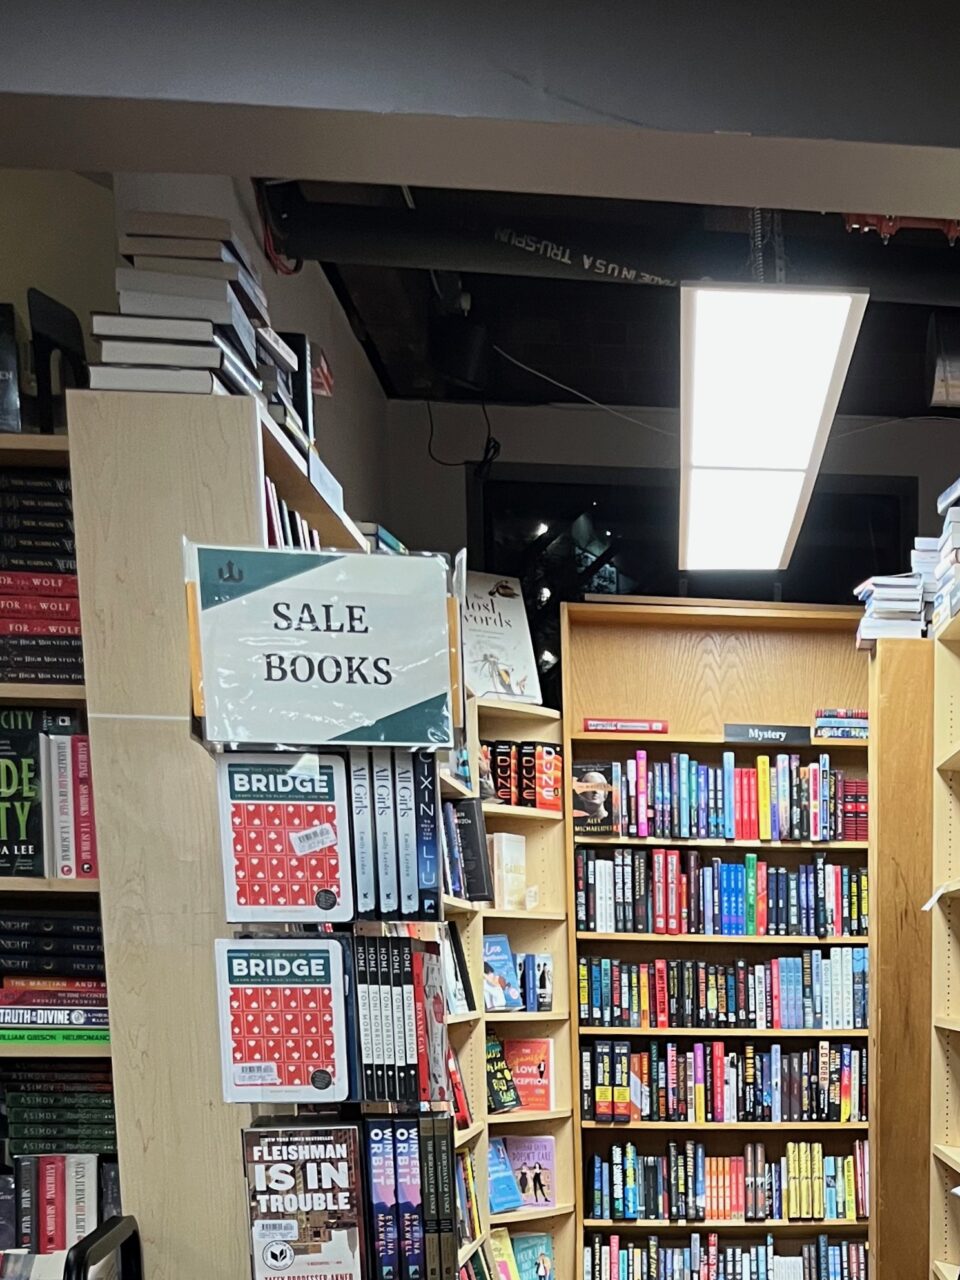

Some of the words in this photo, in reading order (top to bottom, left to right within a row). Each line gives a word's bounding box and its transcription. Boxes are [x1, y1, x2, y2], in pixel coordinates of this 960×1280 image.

[621, 267, 636, 281] IN
[40, 602, 71, 611] WOLF
[465, 595, 495, 614] lost
[272, 601, 369, 634] SALE
[9, 624, 29, 632] FOR
[263, 653, 393, 685] BOOKS
[748, 728, 787, 742] Mystery
[233, 773, 328, 793] BRIDGE
[352, 766, 367, 782] All
[497, 756, 511, 799] DUNE
[355, 783, 368, 816] Girls
[378, 784, 391, 817] Girls
[14, 845, 35, 855] LEE
[232, 958, 325, 977] BRIDGE
[357, 947, 365, 971] HOME
[368, 947, 376, 972] HOME
[29, 980, 67, 988] MARTIAN
[0, 1009, 31, 1024] TRUTH
[37, 1010, 70, 1025] DIVINE
[362, 1014, 370, 1059] MORRISON
[516, 1066, 537, 1074] LOVE
[253, 1143, 347, 1161] FLEISHMAN
[370, 1128, 384, 1185] ORBIT
[396, 1128, 410, 1185] ORBIT
[254, 1163, 296, 1191] IS
[306, 1161, 348, 1190] IN
[256, 1192, 350, 1213] TROUBLE
